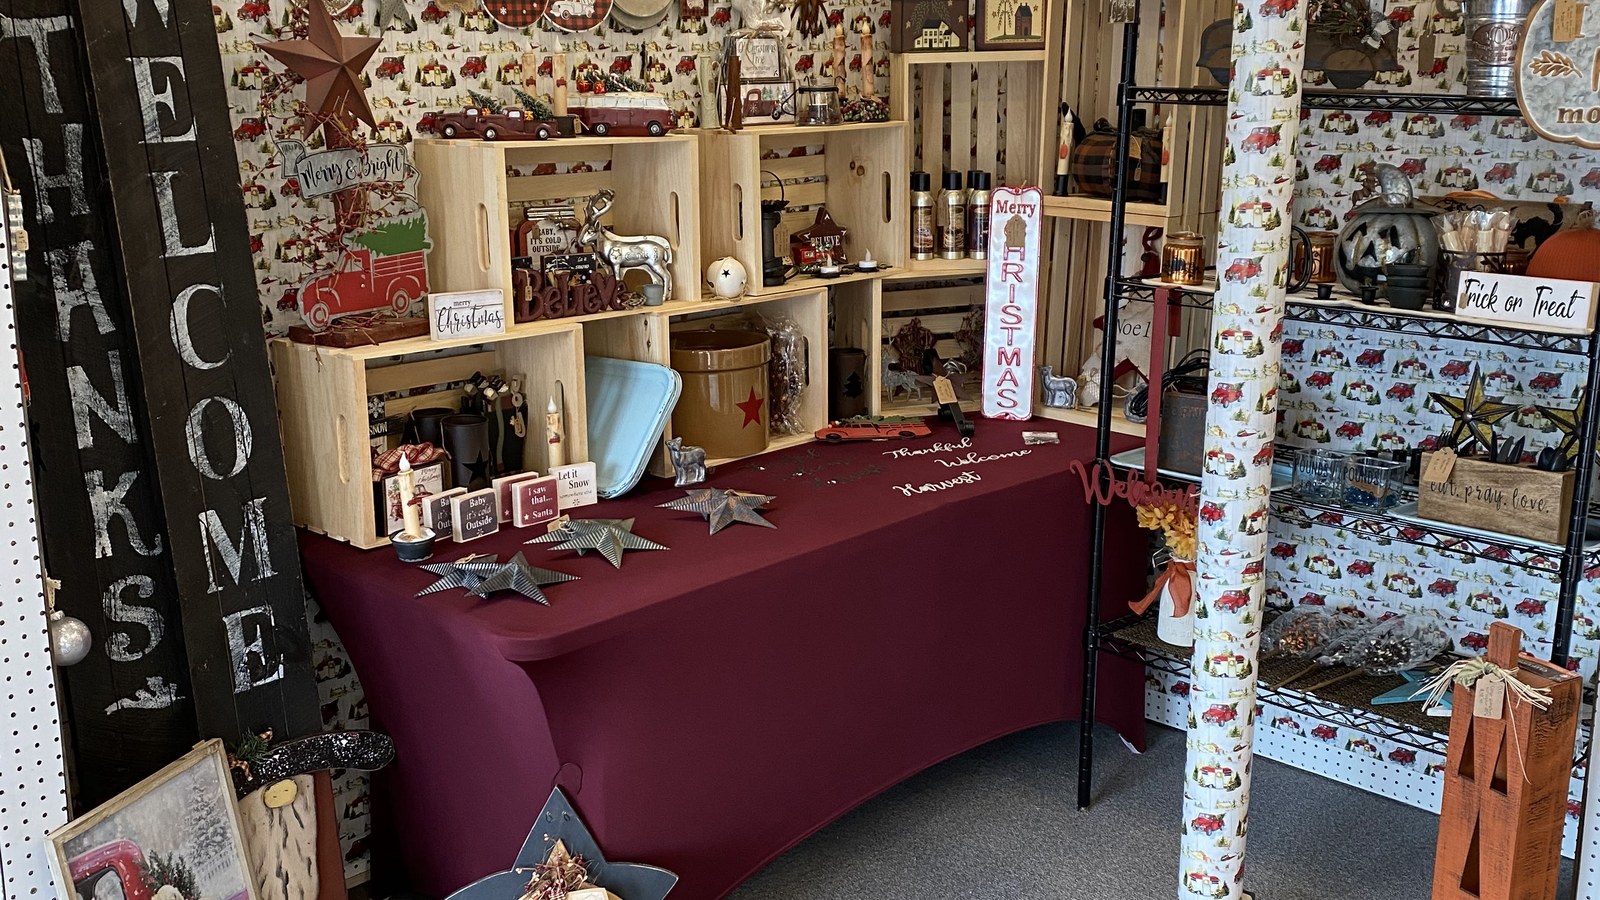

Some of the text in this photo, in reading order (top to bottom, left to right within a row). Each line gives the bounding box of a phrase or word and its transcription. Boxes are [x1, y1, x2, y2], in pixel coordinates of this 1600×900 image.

[300, 160, 343, 189] Merry
[359, 149, 400, 179] Bright
[995, 199, 1036, 217] Merry
[538, 228, 556, 236] ABY,
[453, 300, 471, 308] merry
[1465, 278, 1586, 318] Trick or Treat
[437, 304, 504, 335] Christmas
[996, 242, 1025, 408] HRISTMAS
[0, 15, 167, 662] THANKS
[882, 437, 972, 459] Thankful
[934, 449, 1032, 468] Welcome
[558, 469, 578, 481] Let it
[892, 470, 981, 497] Harvest
[532, 486, 547, 494] saw
[568, 480, 590, 490] Snow
[469, 496, 487, 508] Baby
[532, 508, 553, 519] Santa
[466, 515, 493, 531] Outside
